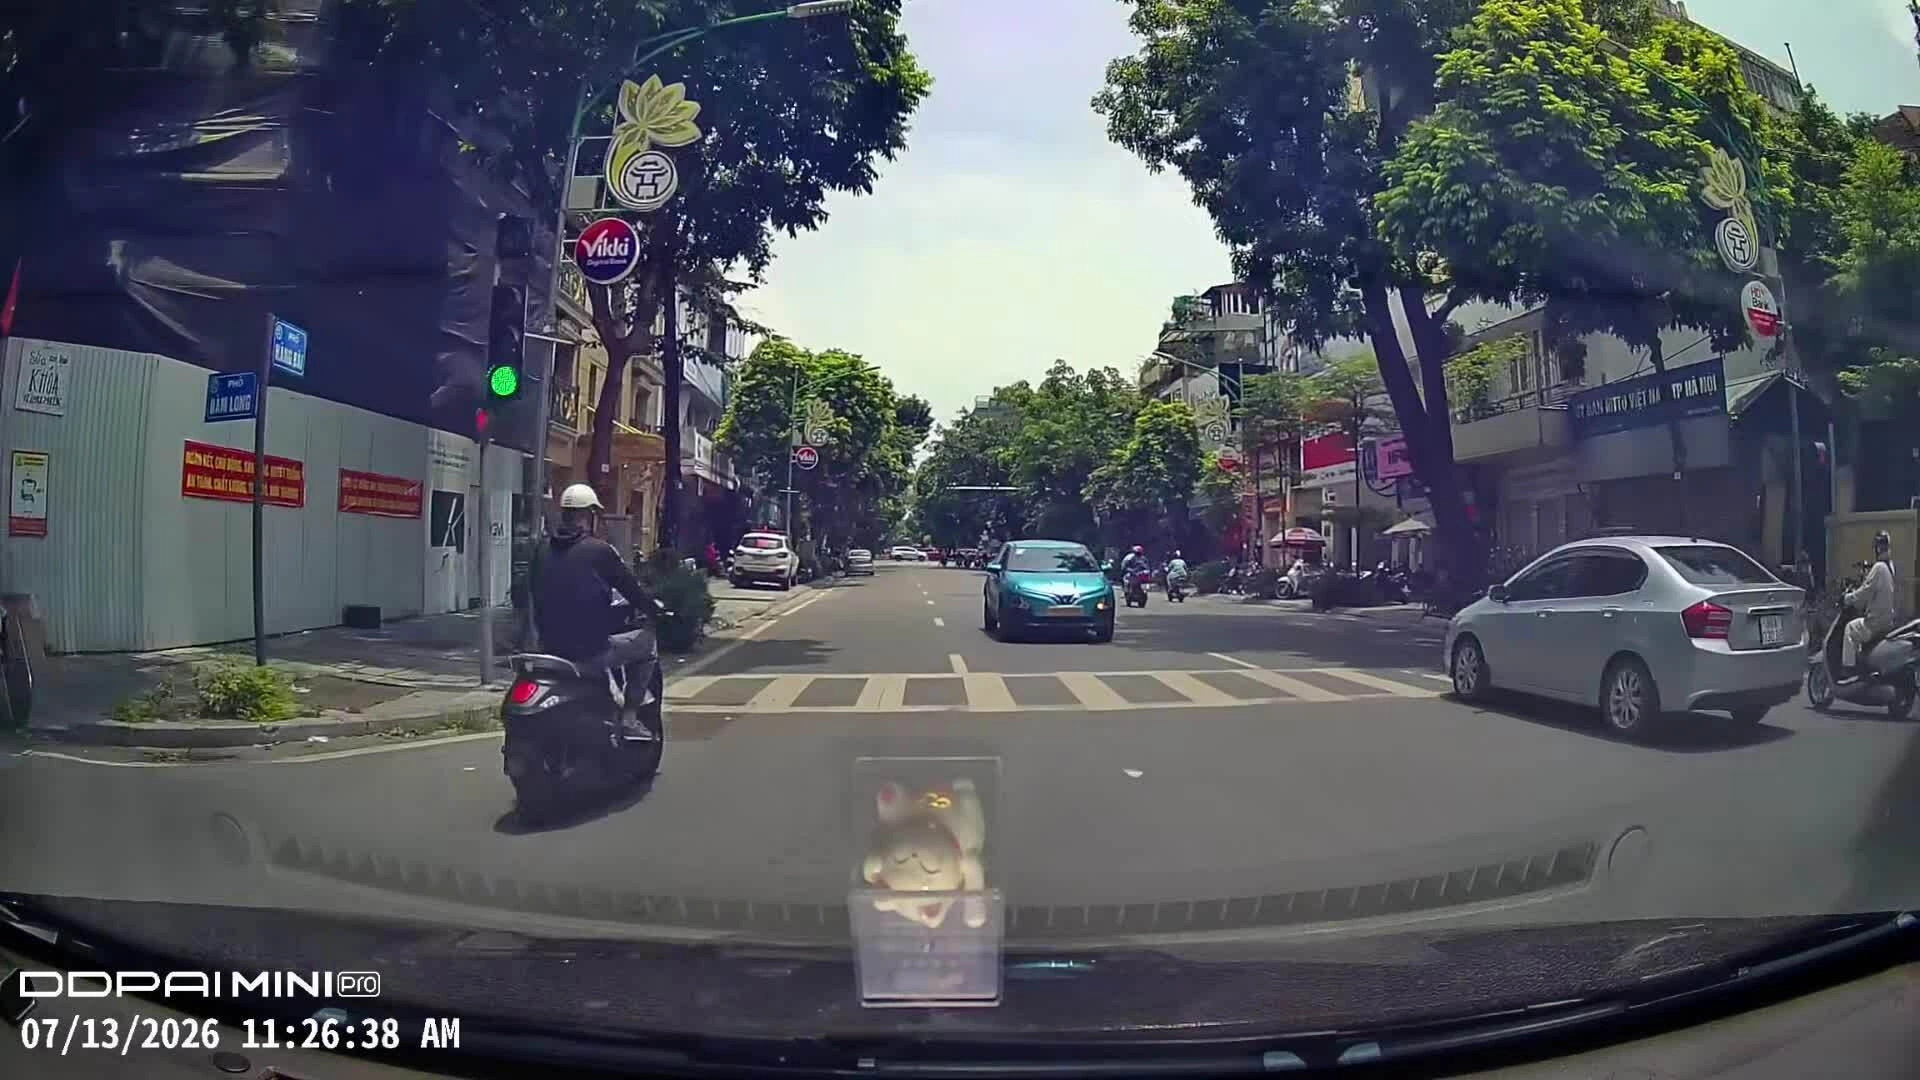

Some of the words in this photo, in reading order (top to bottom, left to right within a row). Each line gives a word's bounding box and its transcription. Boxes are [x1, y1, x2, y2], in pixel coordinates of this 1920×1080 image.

[581, 229, 630, 258] Vikki
[1685, 375, 1699, 398] HÀ
[1700, 372, 1718, 396] NỘI
[229, 394, 251, 412] LONG
